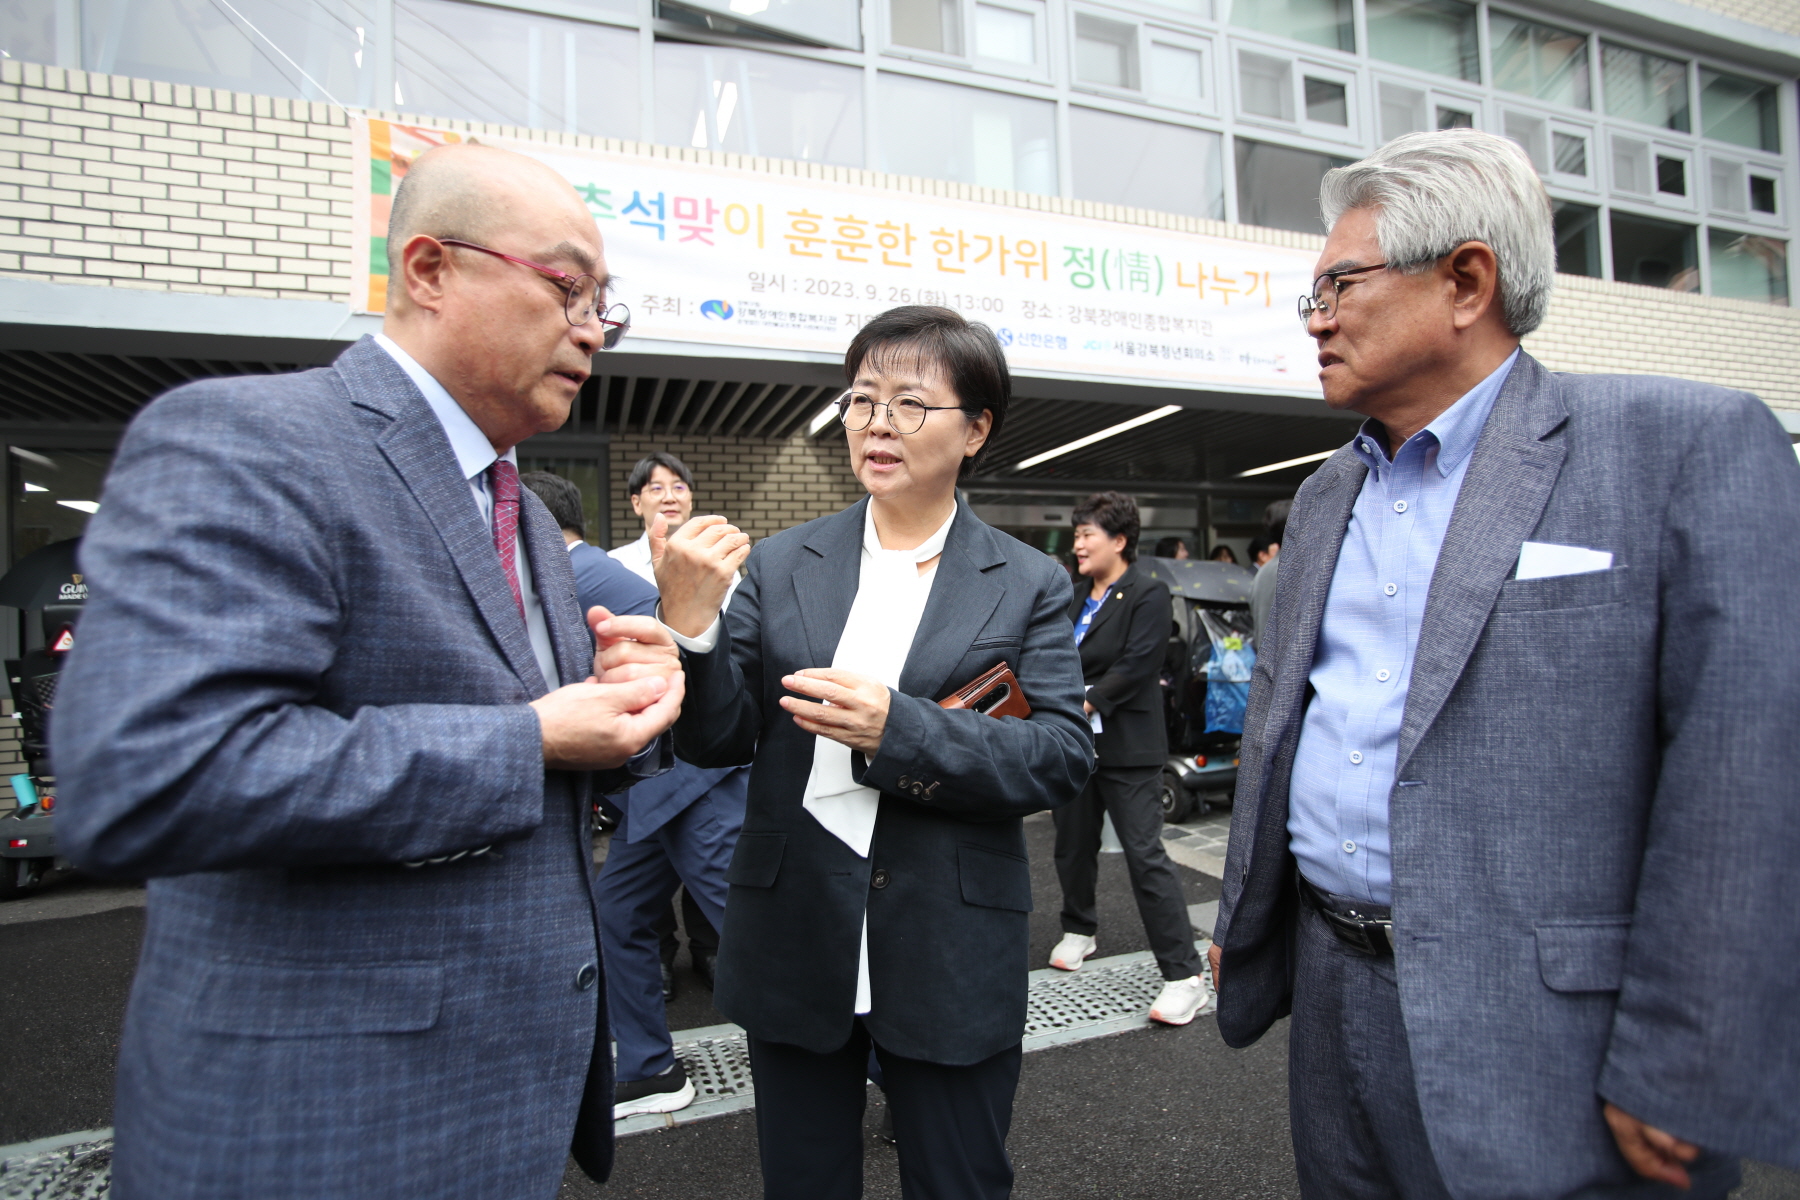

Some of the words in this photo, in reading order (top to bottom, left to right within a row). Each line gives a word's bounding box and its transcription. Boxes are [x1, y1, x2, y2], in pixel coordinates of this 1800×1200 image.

[783, 208, 917, 268] 훈훈한
[930, 225, 1049, 281] 한가위
[1062, 244, 1165, 297] 정(情)
[1176, 260, 1272, 308] 나누기
[954, 294, 1004, 313] 13:00
[1068, 305, 1213, 337] 강북장애인종합복지관
[1017, 332, 1068, 350] 신한은행
[1113, 340, 1216, 361] 서울강북청년회의소
